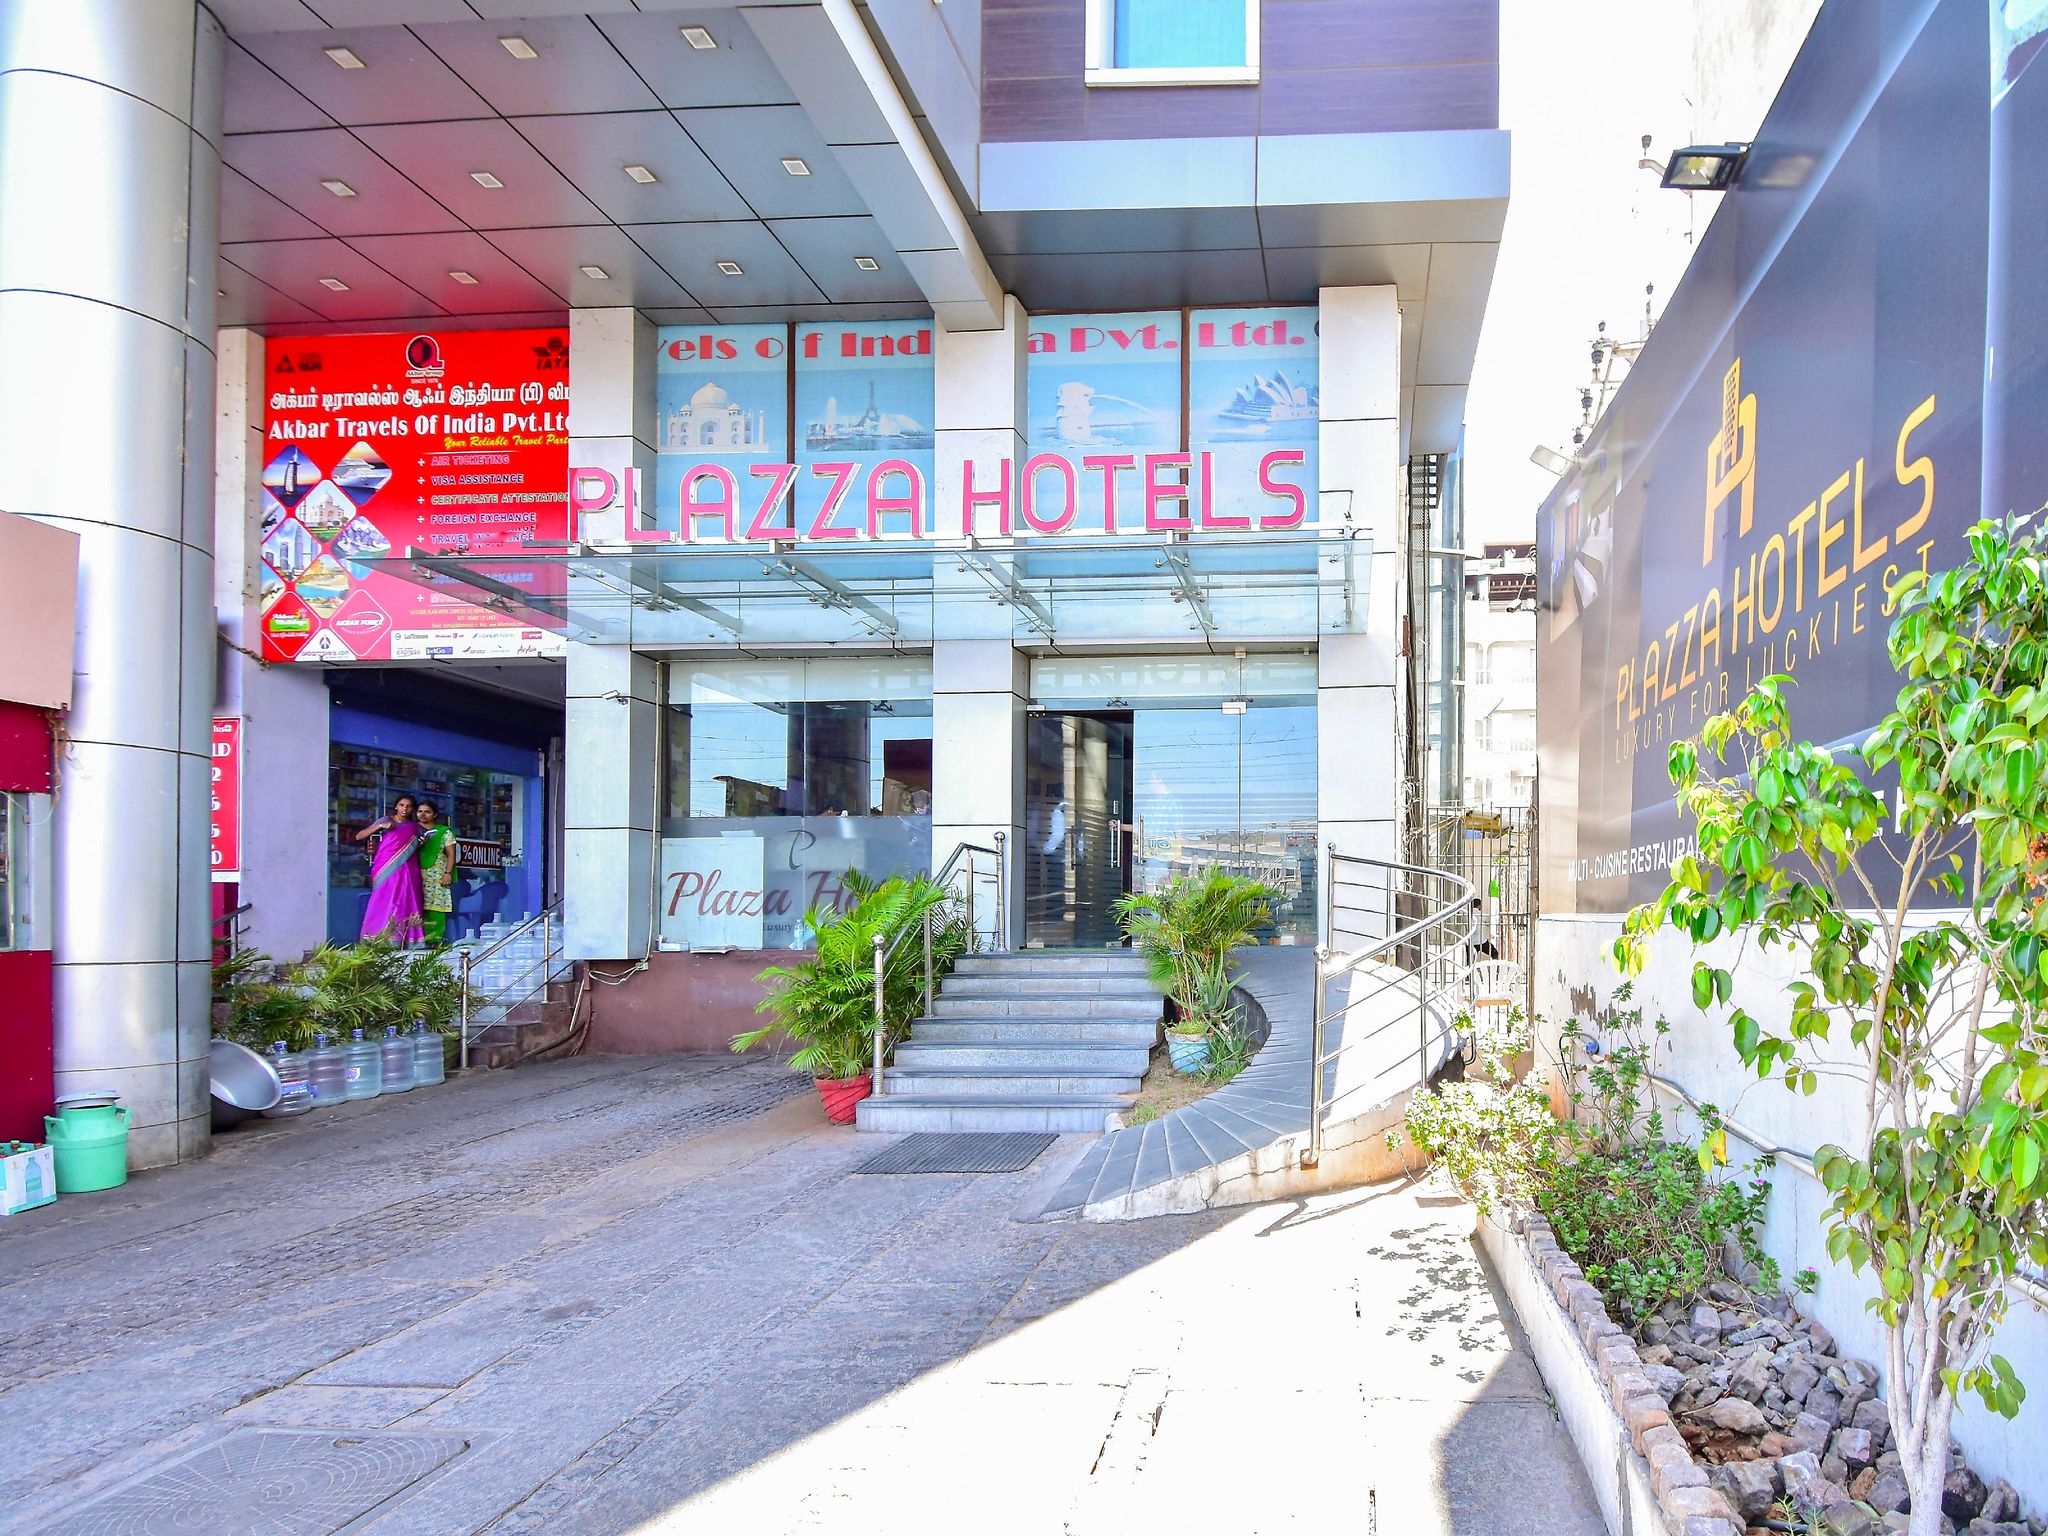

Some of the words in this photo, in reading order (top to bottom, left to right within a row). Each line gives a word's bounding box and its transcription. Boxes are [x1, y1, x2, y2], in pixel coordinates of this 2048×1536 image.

[1070, 323, 1178, 353] Pvt.
[1198, 320, 1305, 348] Ltd.
[269, 419, 329, 439] Akbar
[335, 416, 408, 437] Travels
[414, 414, 438, 435] Of
[444, 412, 496, 434] India
[444, 437, 466, 449] Your
[469, 435, 509, 447] Reliable
[512, 434, 543, 445] Travel
[546, 433, 569, 445] Part
[431, 456, 450, 466] AIR
[453, 455, 510, 465] TICKETING
[431, 475, 455, 485] VISA
[459, 474, 524, 485] ASSISTANCE
[431, 494, 498, 505] CERTIFICATE
[569, 459, 927, 543] PLAZZA
[961, 449, 1308, 537] HOTELS
[431, 513, 476, 524] FOREIGN
[480, 512, 536, 523] EXCHANGE
[431, 533, 469, 544] TRAVEL
[1616, 588, 1721, 730] PLAZZA
[1731, 394, 1936, 655] HOTELS
[1616, 704, 1676, 764] LUXURY
[1690, 671, 1729, 724] FOR
[473, 846, 501, 866] ONLINE
[1594, 850, 1628, 879] CUISINE
[666, 868, 792, 917] Plaza
